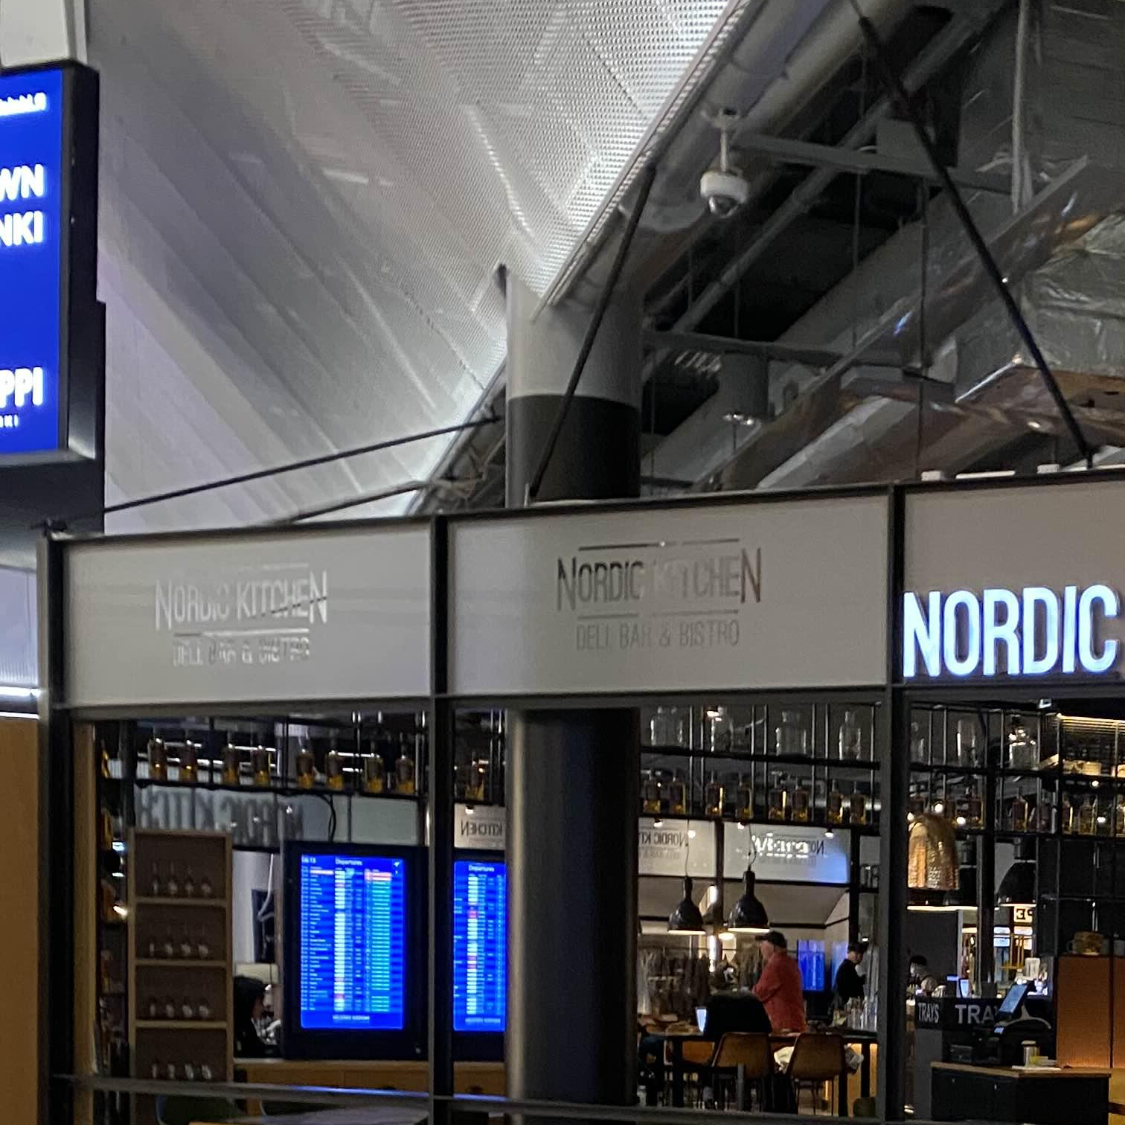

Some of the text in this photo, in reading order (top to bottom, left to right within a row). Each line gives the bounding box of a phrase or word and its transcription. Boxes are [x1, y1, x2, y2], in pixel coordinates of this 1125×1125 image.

[155, 570, 328, 630] NORDIC KITCHEN
[557, 557, 644, 612] NORDIC
[619, 621, 652, 649] BAR
[658, 622, 671, 648] &
[679, 619, 740, 648] BISTRO
[902, 583, 1120, 679] NORDIC
[917, 1002, 940, 1024] TRAYS
